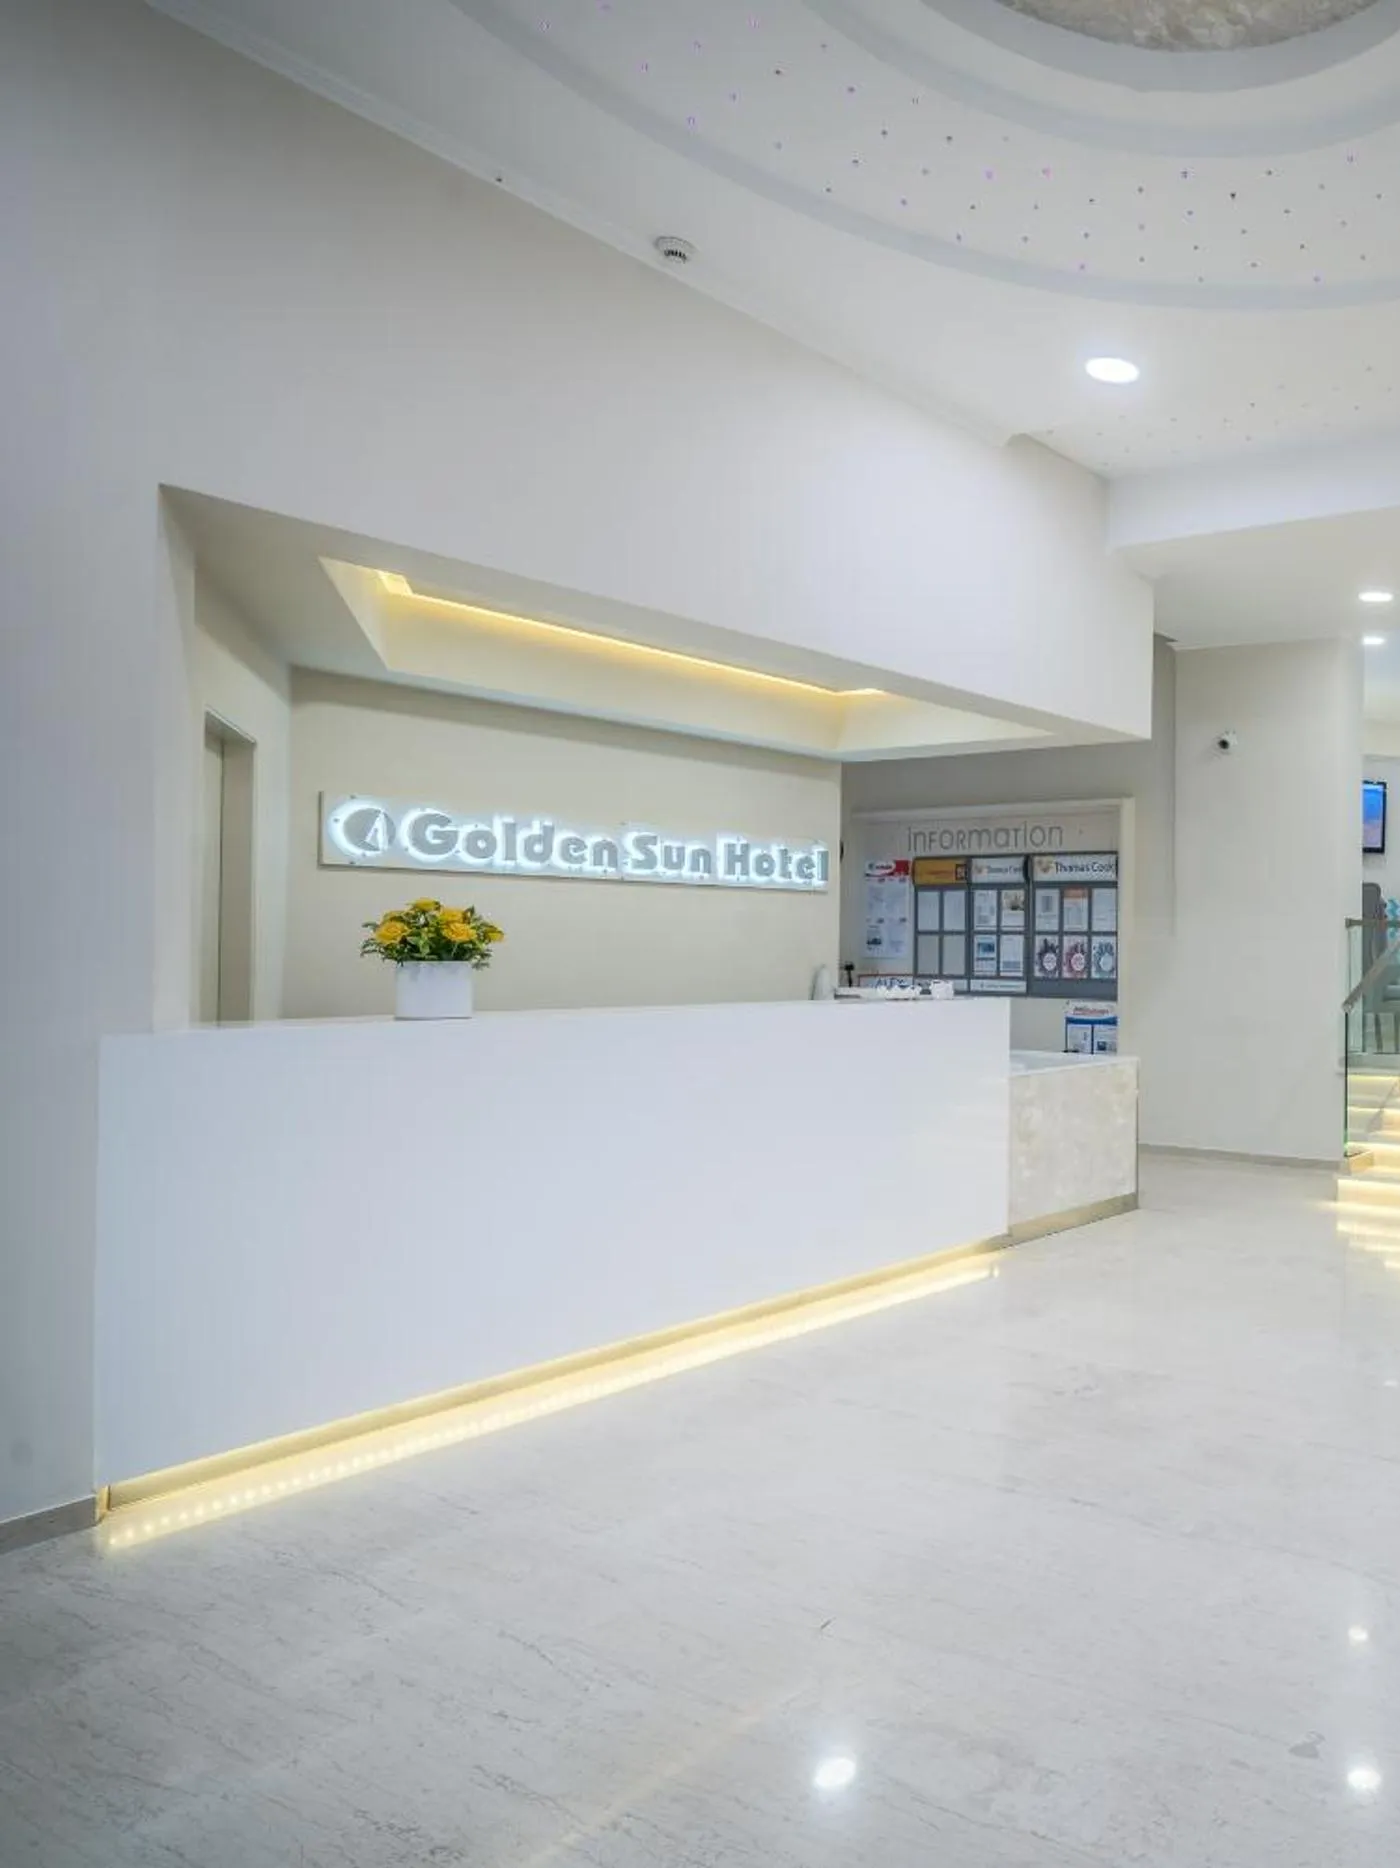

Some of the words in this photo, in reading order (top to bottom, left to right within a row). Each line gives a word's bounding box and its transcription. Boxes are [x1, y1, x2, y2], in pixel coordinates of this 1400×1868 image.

[405, 810, 619, 870] Golden
[629, 833, 713, 874] Sun
[722, 840, 829, 882] Hotel
